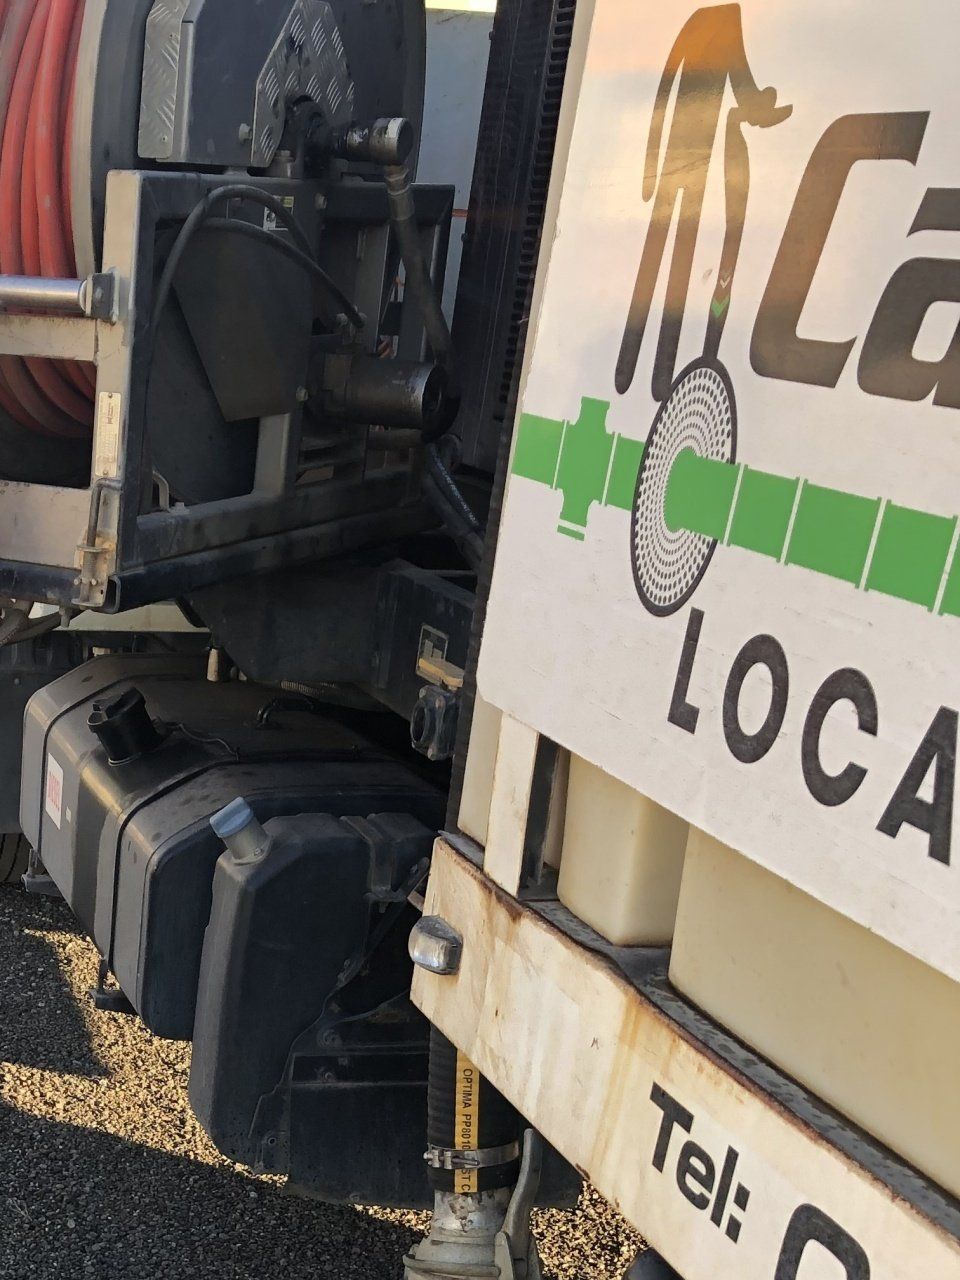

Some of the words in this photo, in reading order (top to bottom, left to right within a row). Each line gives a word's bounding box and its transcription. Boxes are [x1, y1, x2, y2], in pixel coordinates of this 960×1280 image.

[667, 606, 960, 867] LOCA
[462, 1068, 473, 1109] OPTIMA
[649, 1081, 751, 1245] Tel:
